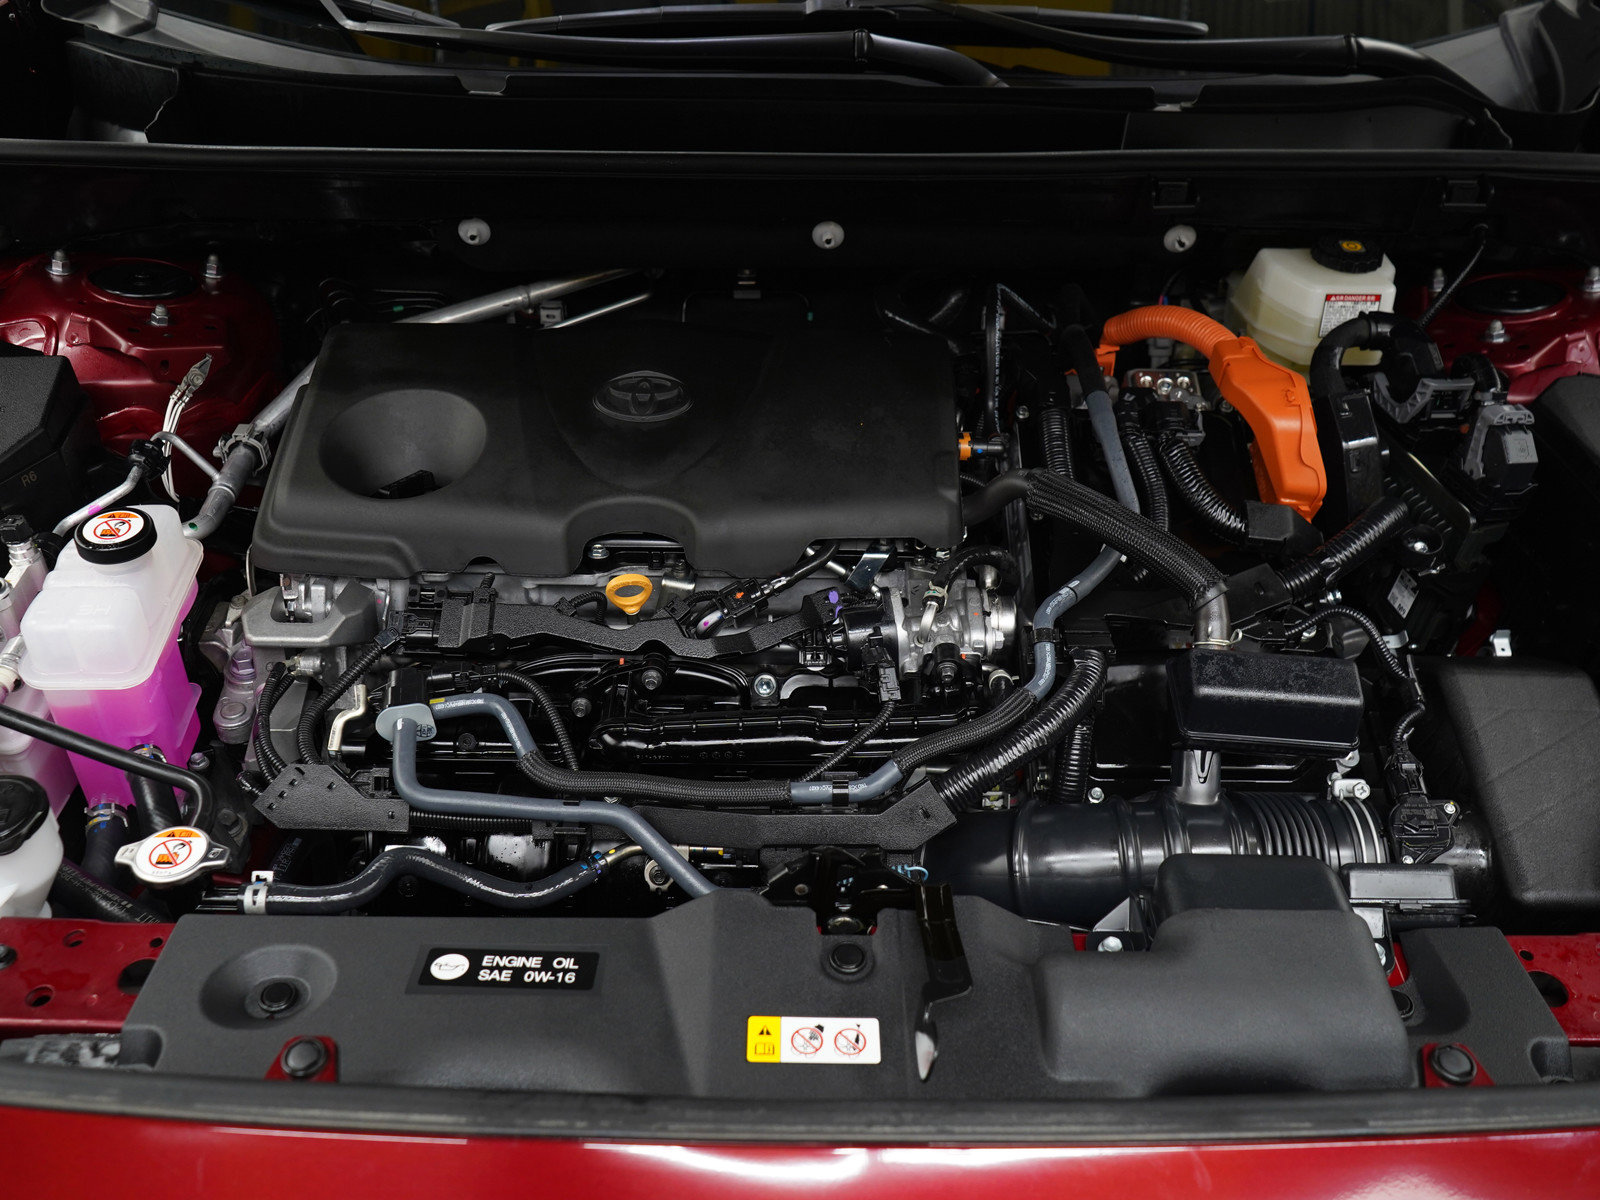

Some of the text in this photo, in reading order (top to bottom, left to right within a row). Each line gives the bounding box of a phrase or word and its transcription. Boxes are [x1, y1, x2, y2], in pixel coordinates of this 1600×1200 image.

[21, 470, 38, 487] R6
[482, 955, 579, 969] ENGINE OIL
[477, 969, 576, 983] SAE 0W-16
